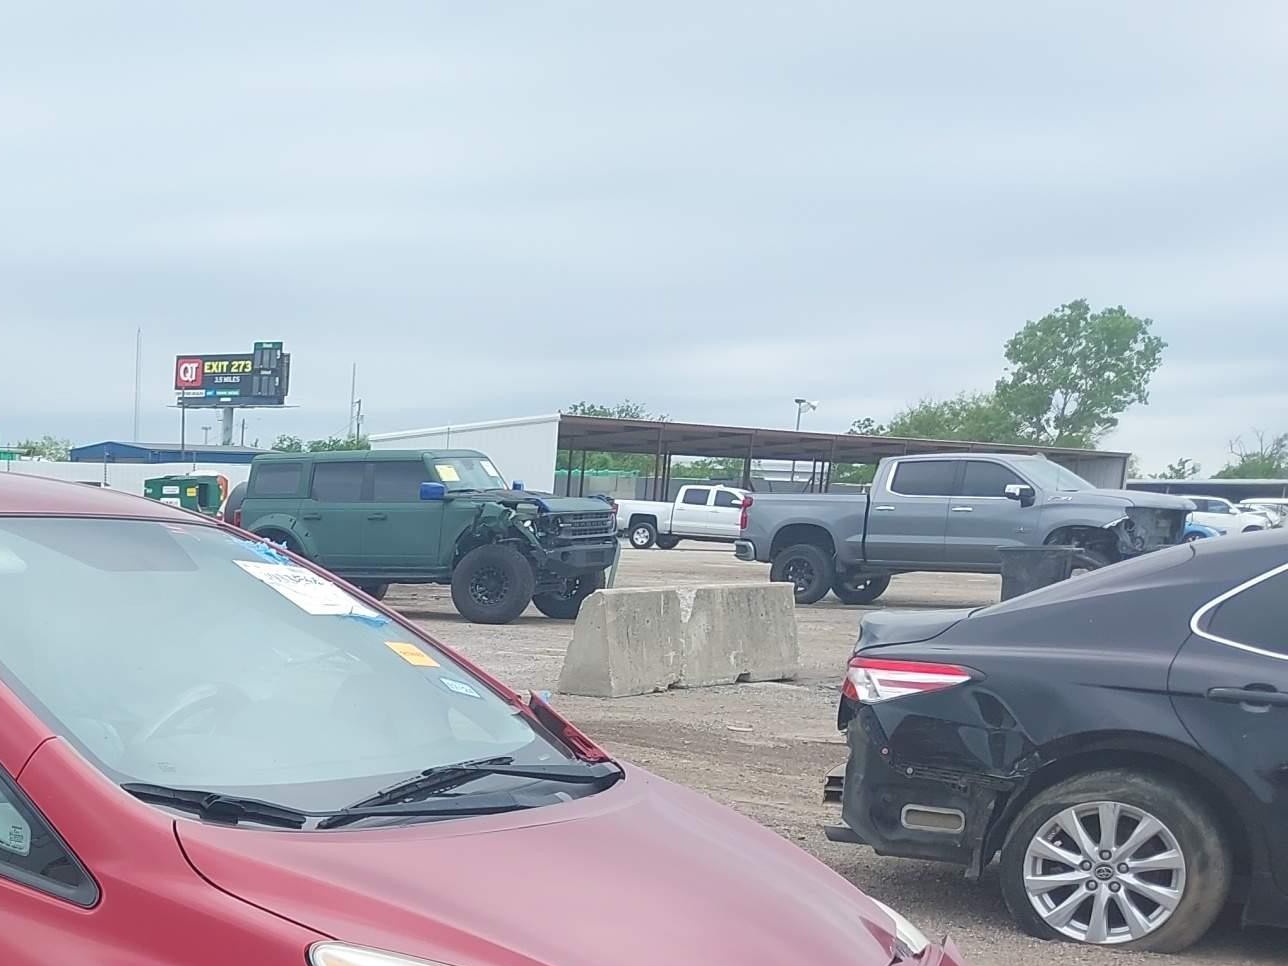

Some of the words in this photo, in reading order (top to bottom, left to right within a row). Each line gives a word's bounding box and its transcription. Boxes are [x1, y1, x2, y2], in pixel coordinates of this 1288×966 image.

[179, 363, 199, 381] QT
[204, 361, 229, 373] EXIT
[231, 360, 252, 372] 273
